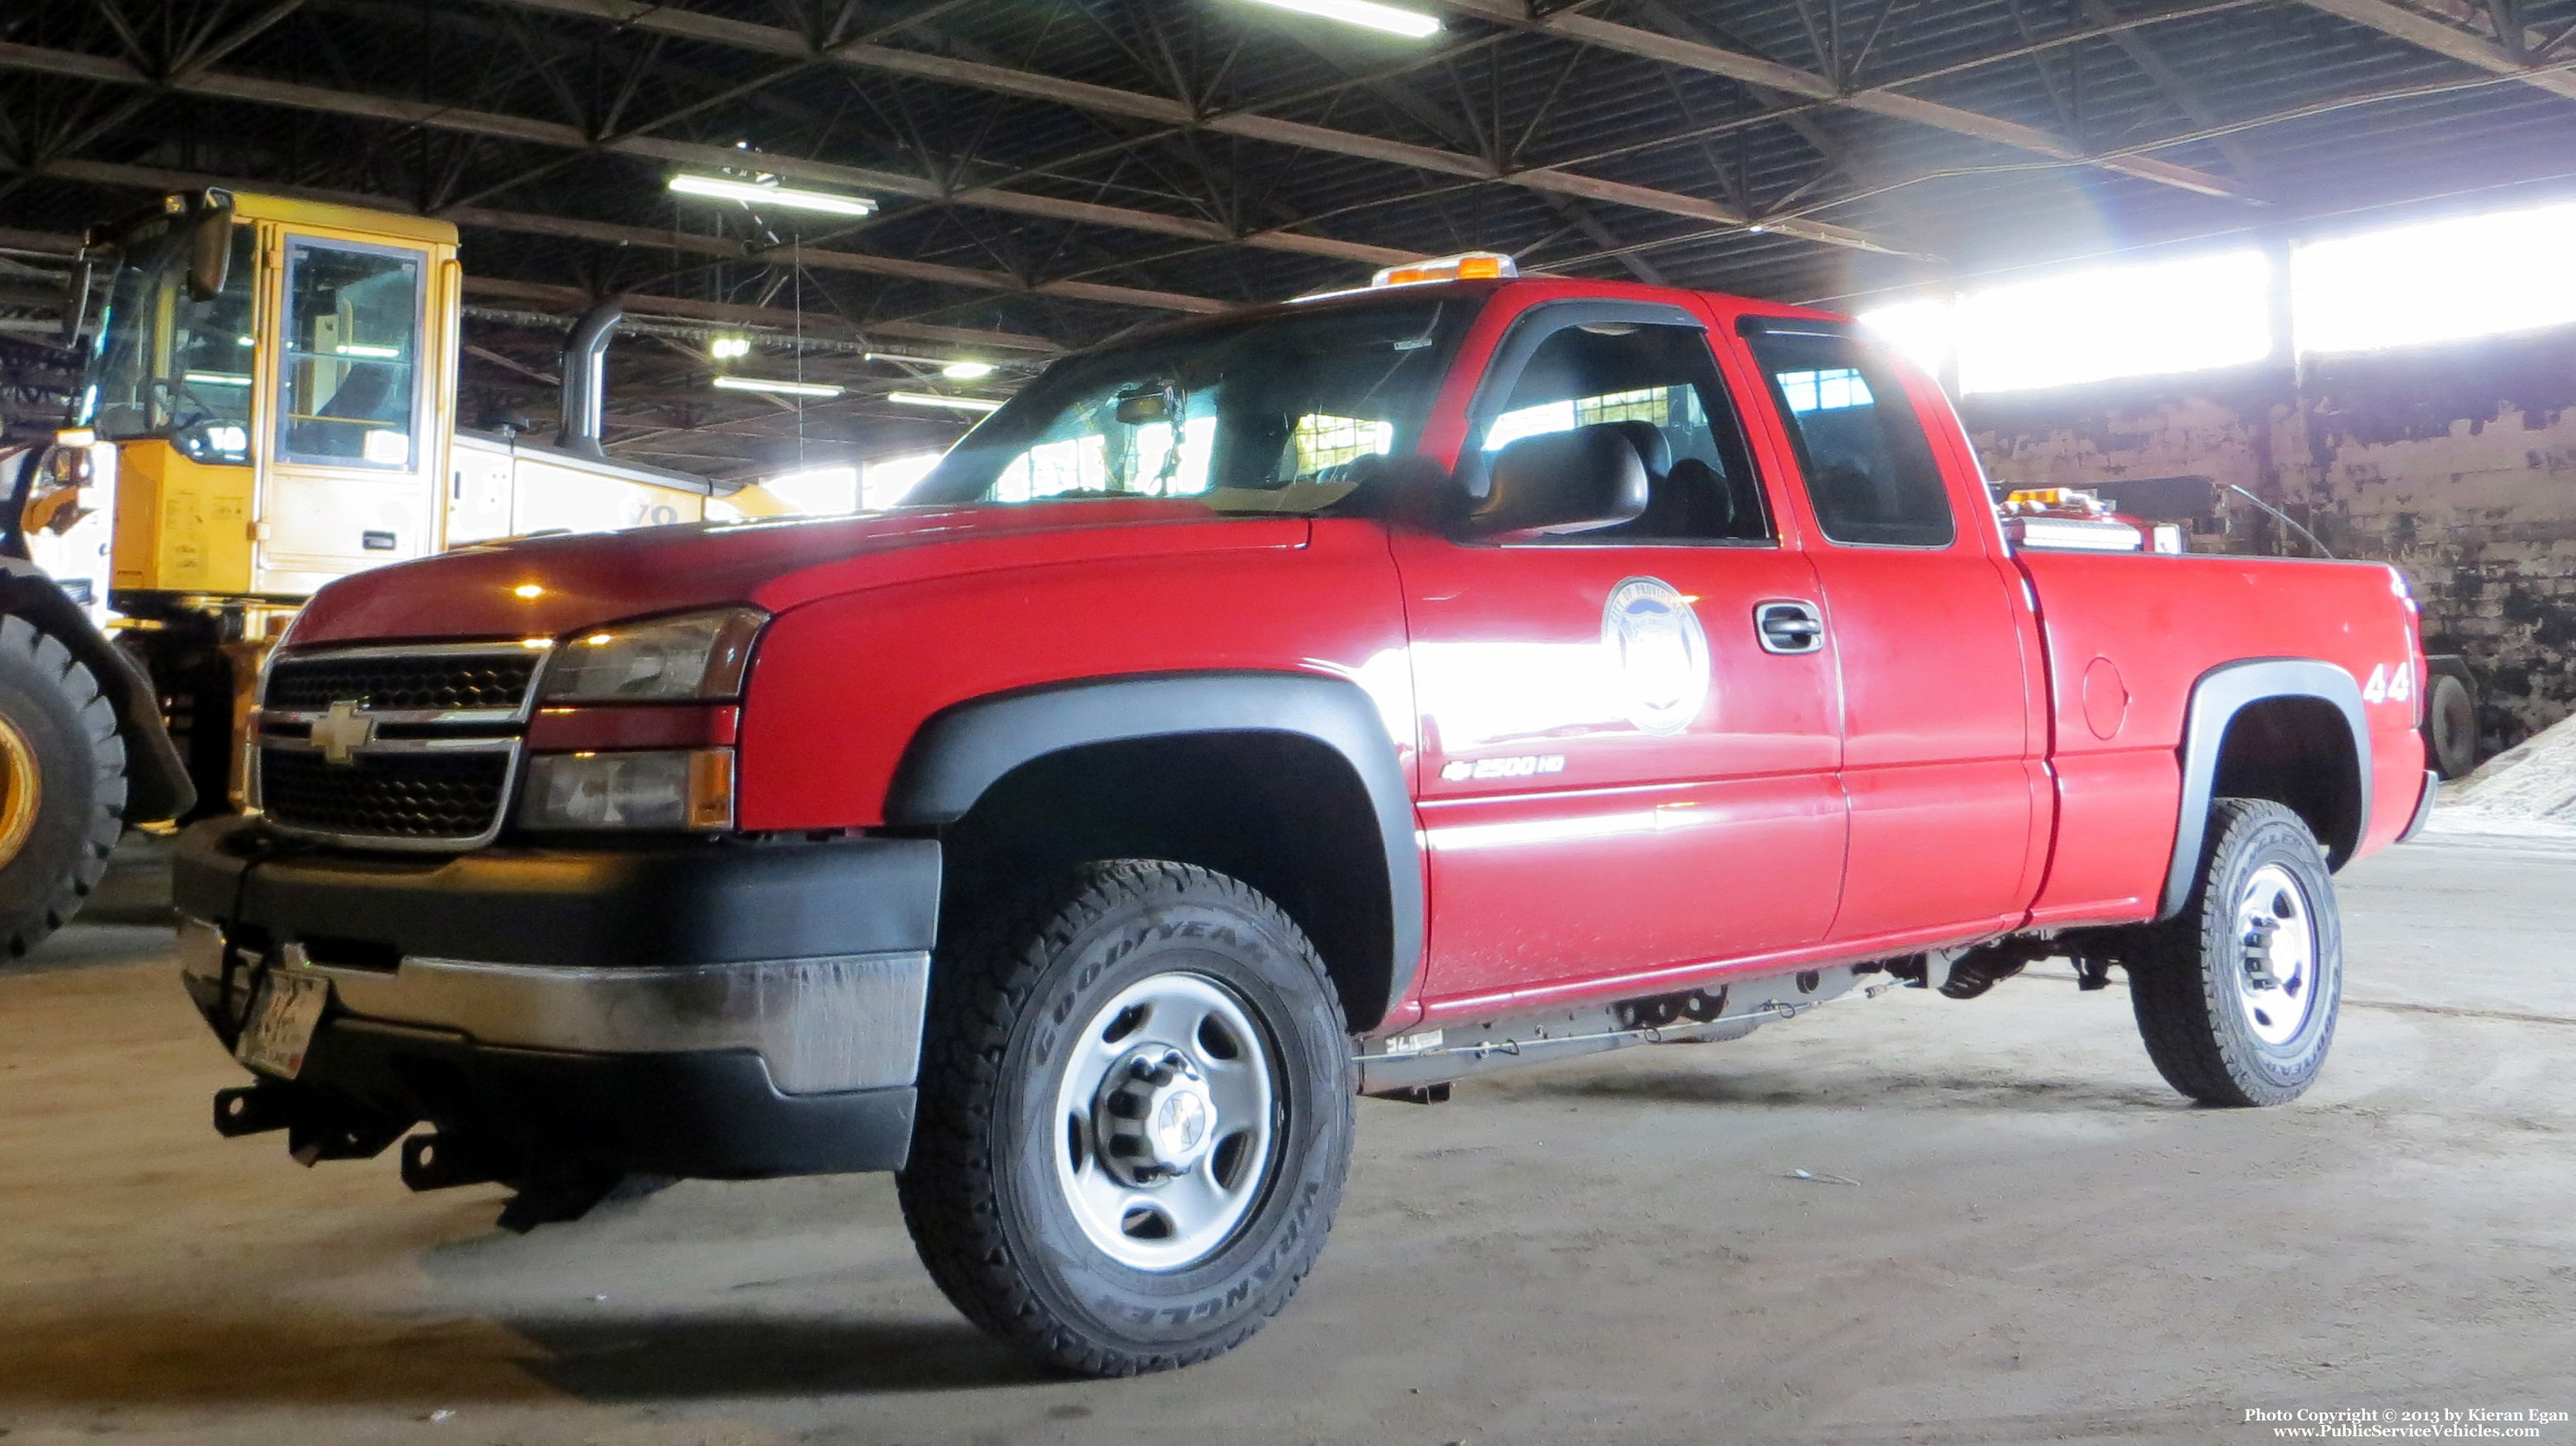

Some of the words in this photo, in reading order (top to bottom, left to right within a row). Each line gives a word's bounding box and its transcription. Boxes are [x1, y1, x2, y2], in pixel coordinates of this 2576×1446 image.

[1611, 598, 1627, 623] CITY
[1623, 587, 1632, 599] OF
[2363, 662, 2409, 704] 44
[1473, 756, 1537, 779] 2500
[1537, 753, 1565, 774] HD
[1035, 920, 1270, 1066] GOODYEAR
